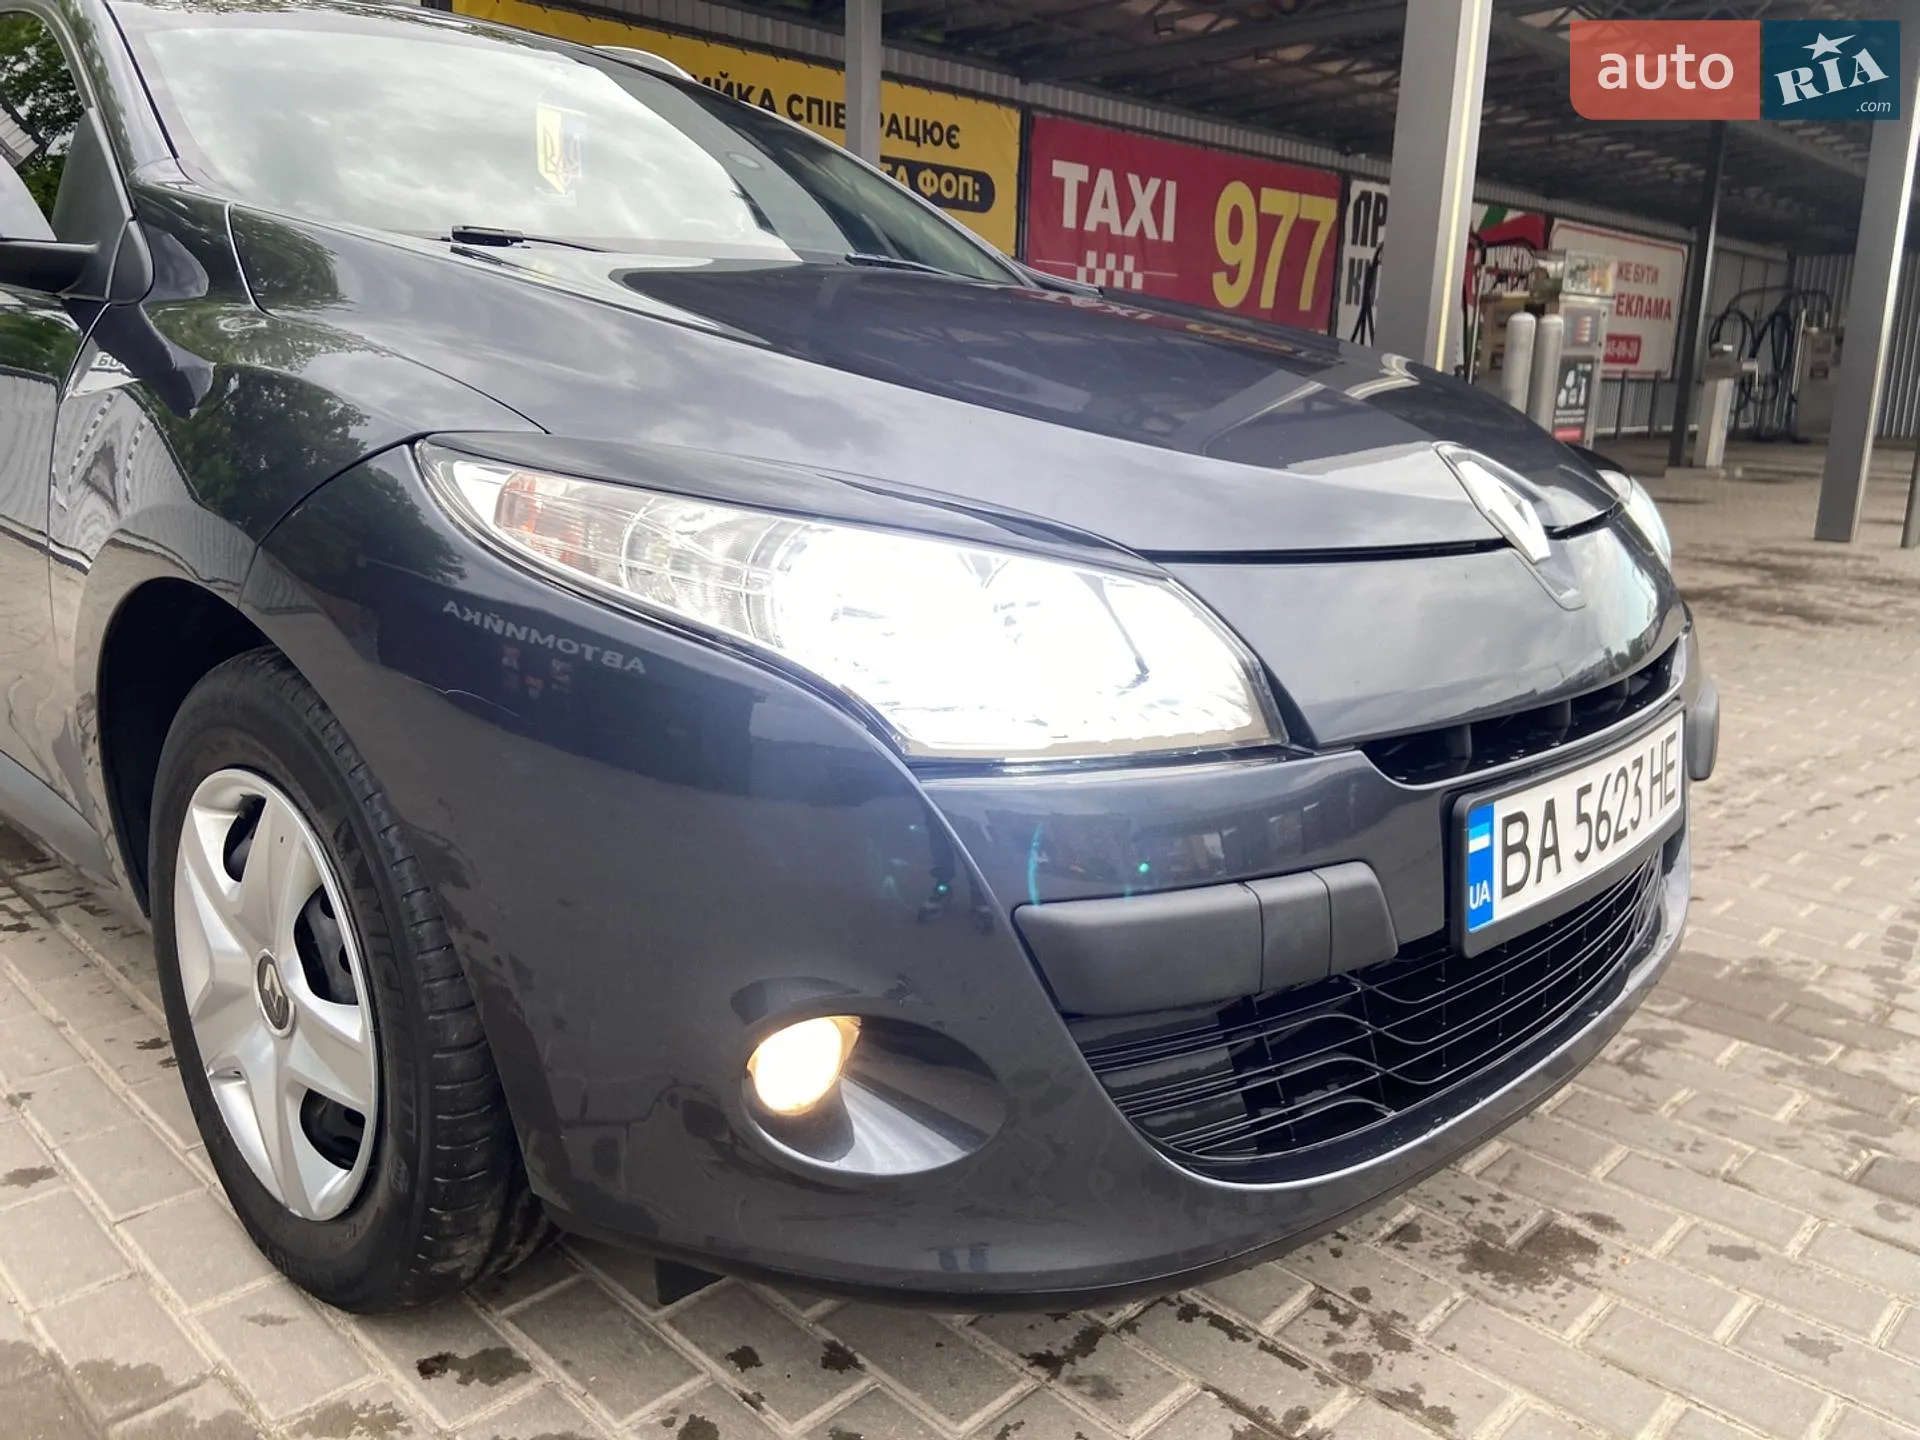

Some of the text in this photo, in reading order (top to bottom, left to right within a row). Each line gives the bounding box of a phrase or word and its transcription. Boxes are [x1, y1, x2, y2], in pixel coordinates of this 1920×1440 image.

[917, 168, 981, 203] ФОП:
[1052, 159, 1338, 311] TAXI 977
[1633, 263, 1659, 285] БУТИ
[1500, 729, 1678, 899] BA 5623 HE
[1469, 882, 1492, 910] UA
